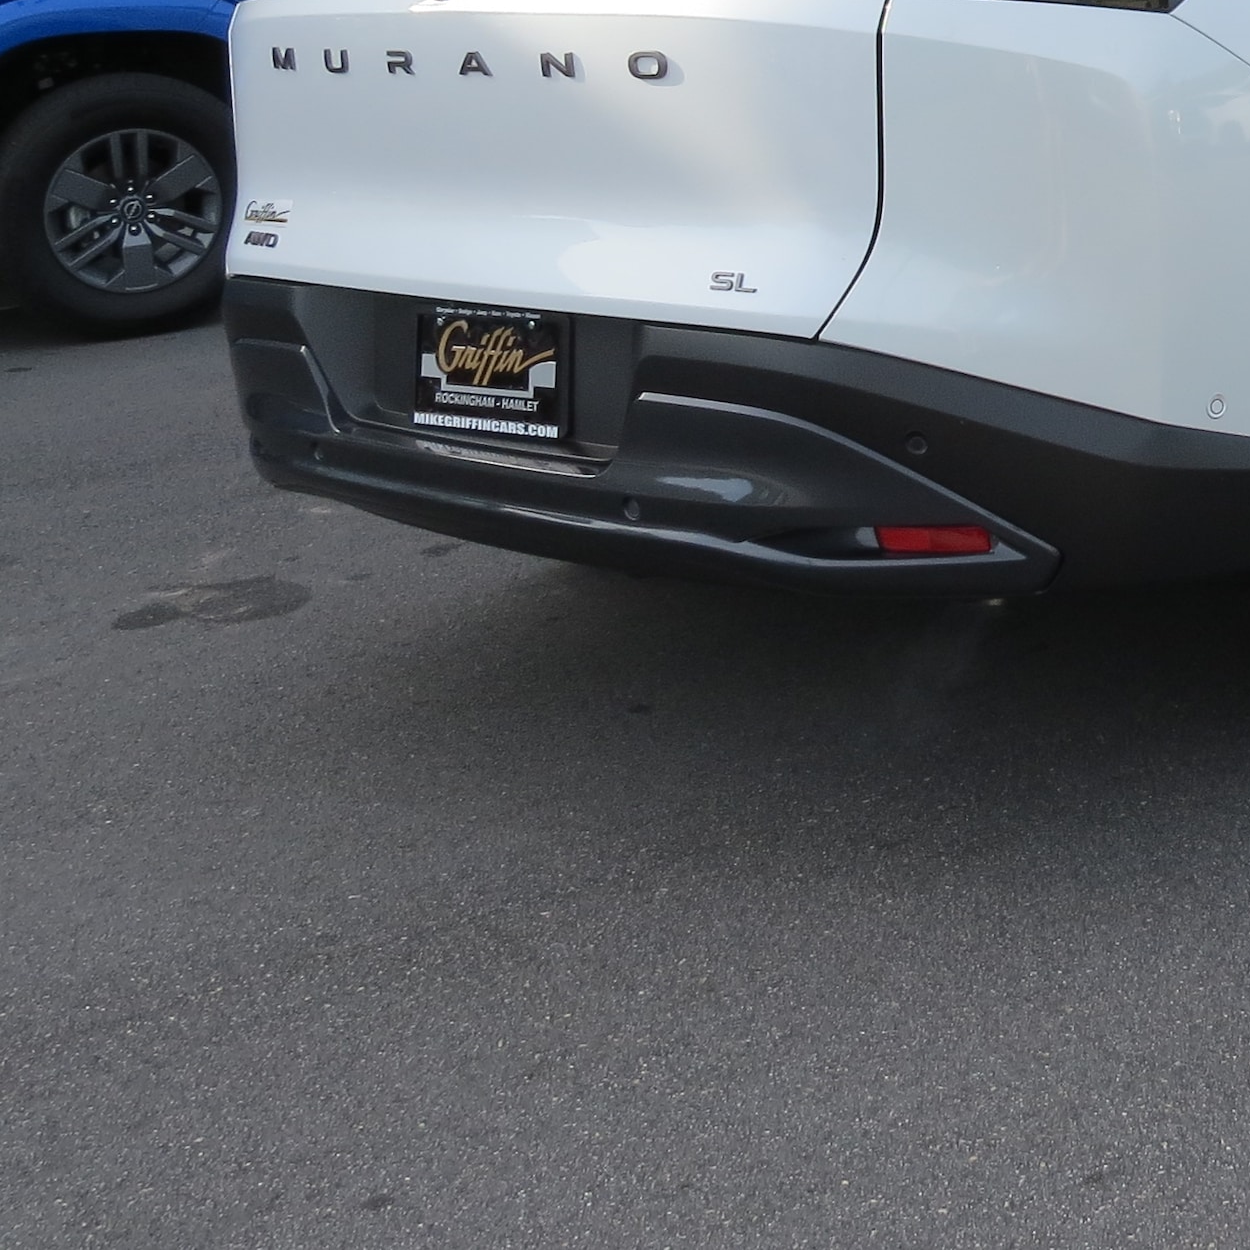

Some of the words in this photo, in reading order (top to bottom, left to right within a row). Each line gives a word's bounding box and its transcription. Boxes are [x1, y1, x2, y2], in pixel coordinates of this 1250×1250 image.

[271, 47, 668, 80] MURANO
[244, 231, 279, 248] AWD
[709, 271, 758, 293] SL
[438, 319, 555, 387] Griffin
[434, 392, 496, 408] ROCKINGHAM
[501, 397, 539, 413] HAMLET
[413, 411, 559, 439] MIKEGRIFFINCARS.COM
